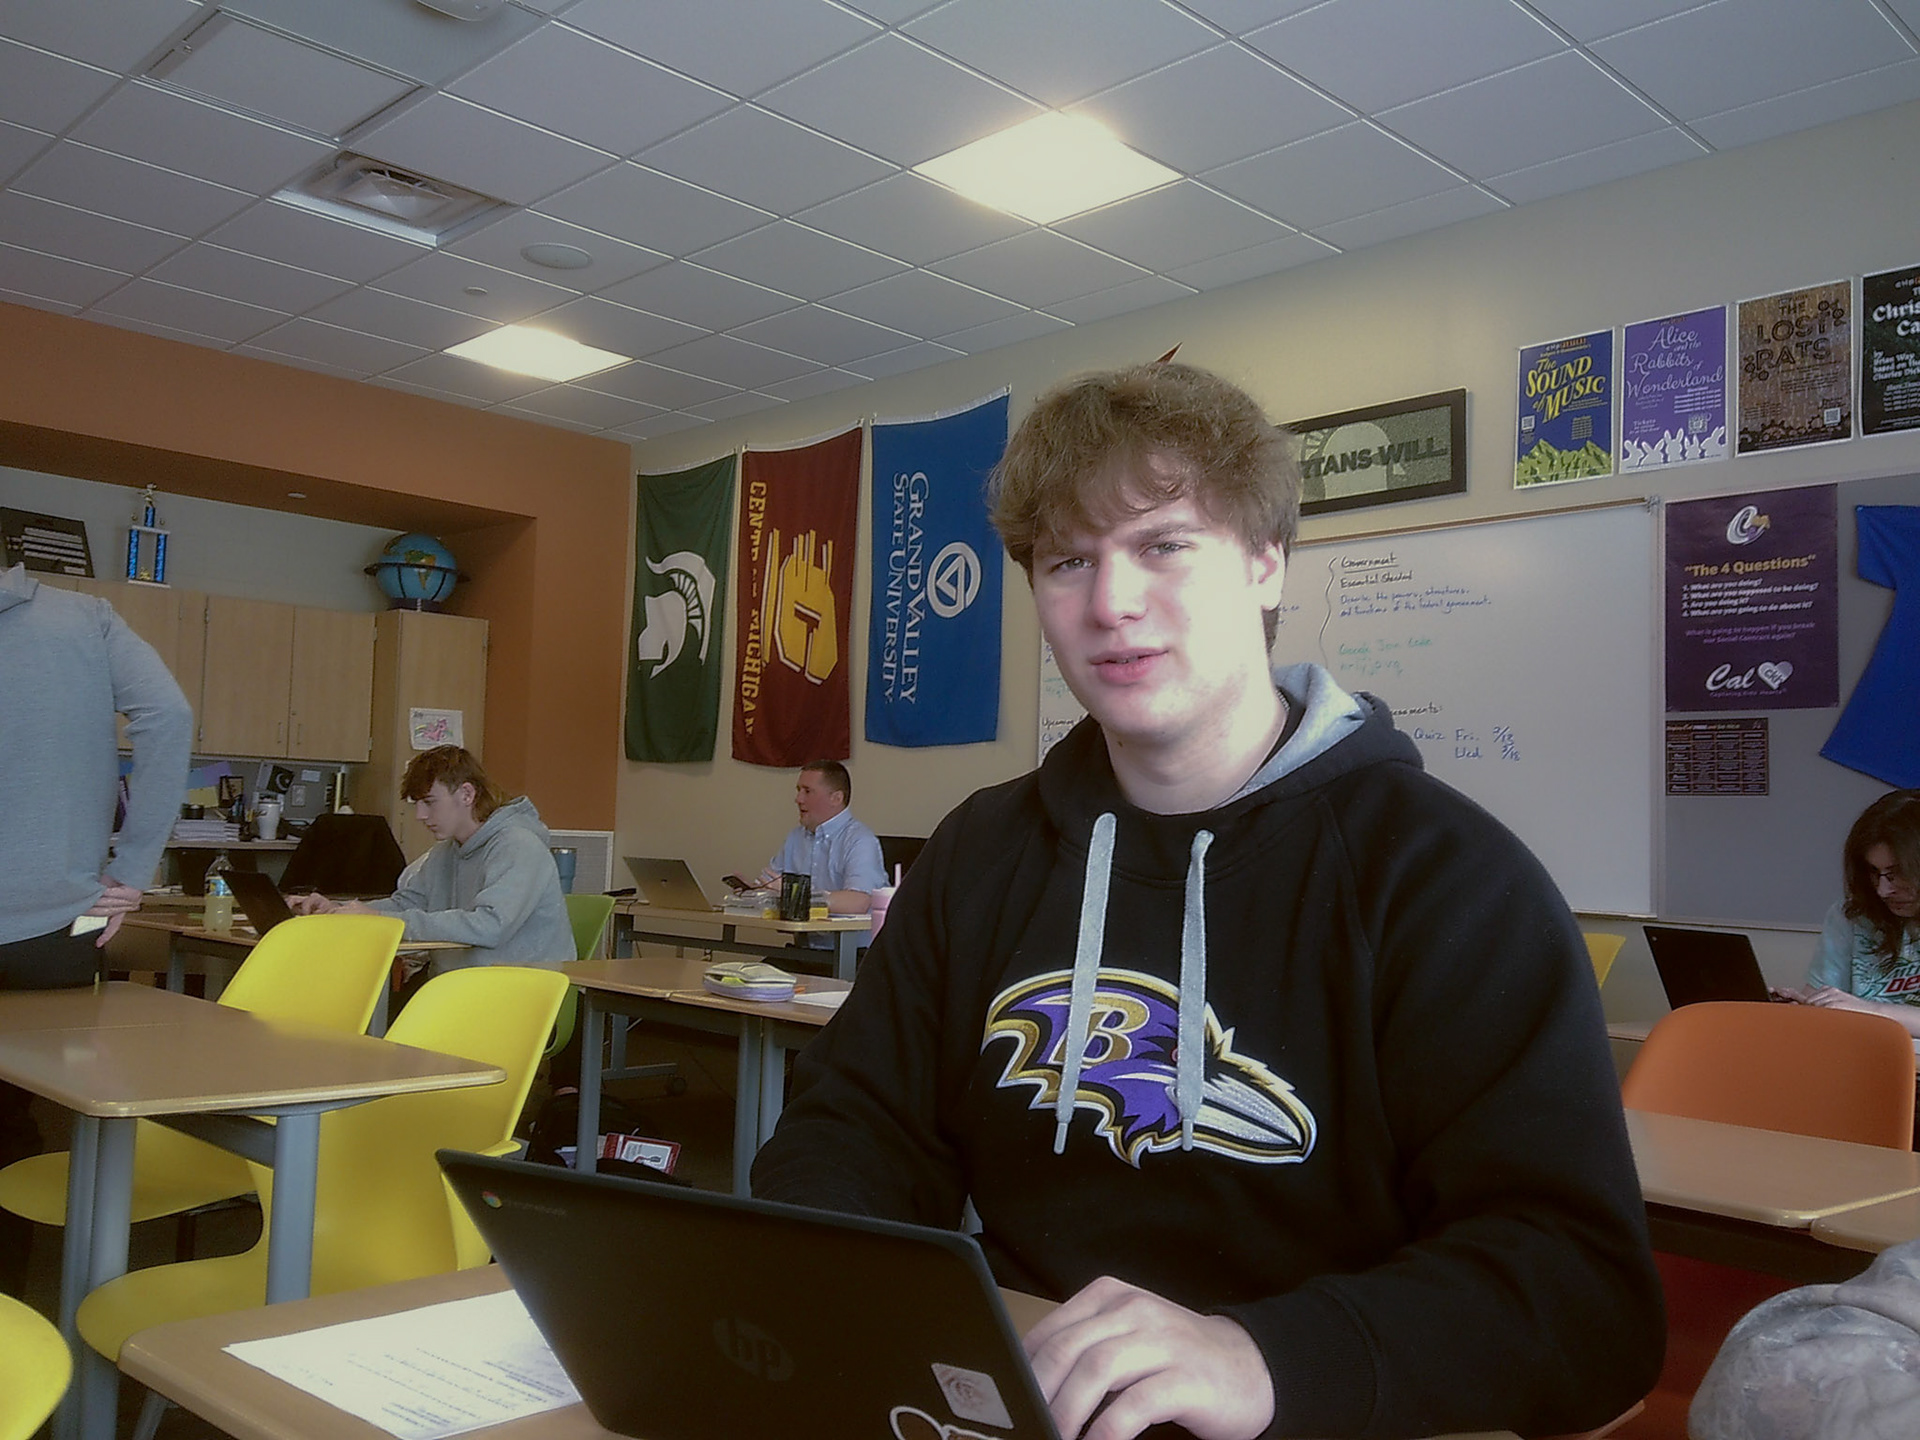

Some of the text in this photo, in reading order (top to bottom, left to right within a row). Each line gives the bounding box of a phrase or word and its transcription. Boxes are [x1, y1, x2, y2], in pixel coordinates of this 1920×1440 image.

[1778, 301, 1806, 316] THE
[1648, 325, 1698, 351] Alice
[1757, 310, 1831, 345] LOST
[1536, 358, 1557, 374] The
[1629, 352, 1694, 375] Rabbits
[1756, 338, 1831, 370] RATS
[1525, 355, 1592, 398] SOUND
[1626, 365, 1724, 398] Wonderland
[1542, 376, 1606, 424] MUSIC
[1720, 562, 1730, 575] 4
[882, 472, 909, 705] STATE UNIVERSITY
[899, 471, 930, 705] GRAND VALLEY
[1705, 663, 1755, 691] Cal
[1413, 727, 1445, 740] Quiz
[1034, 993, 1150, 1067] B
